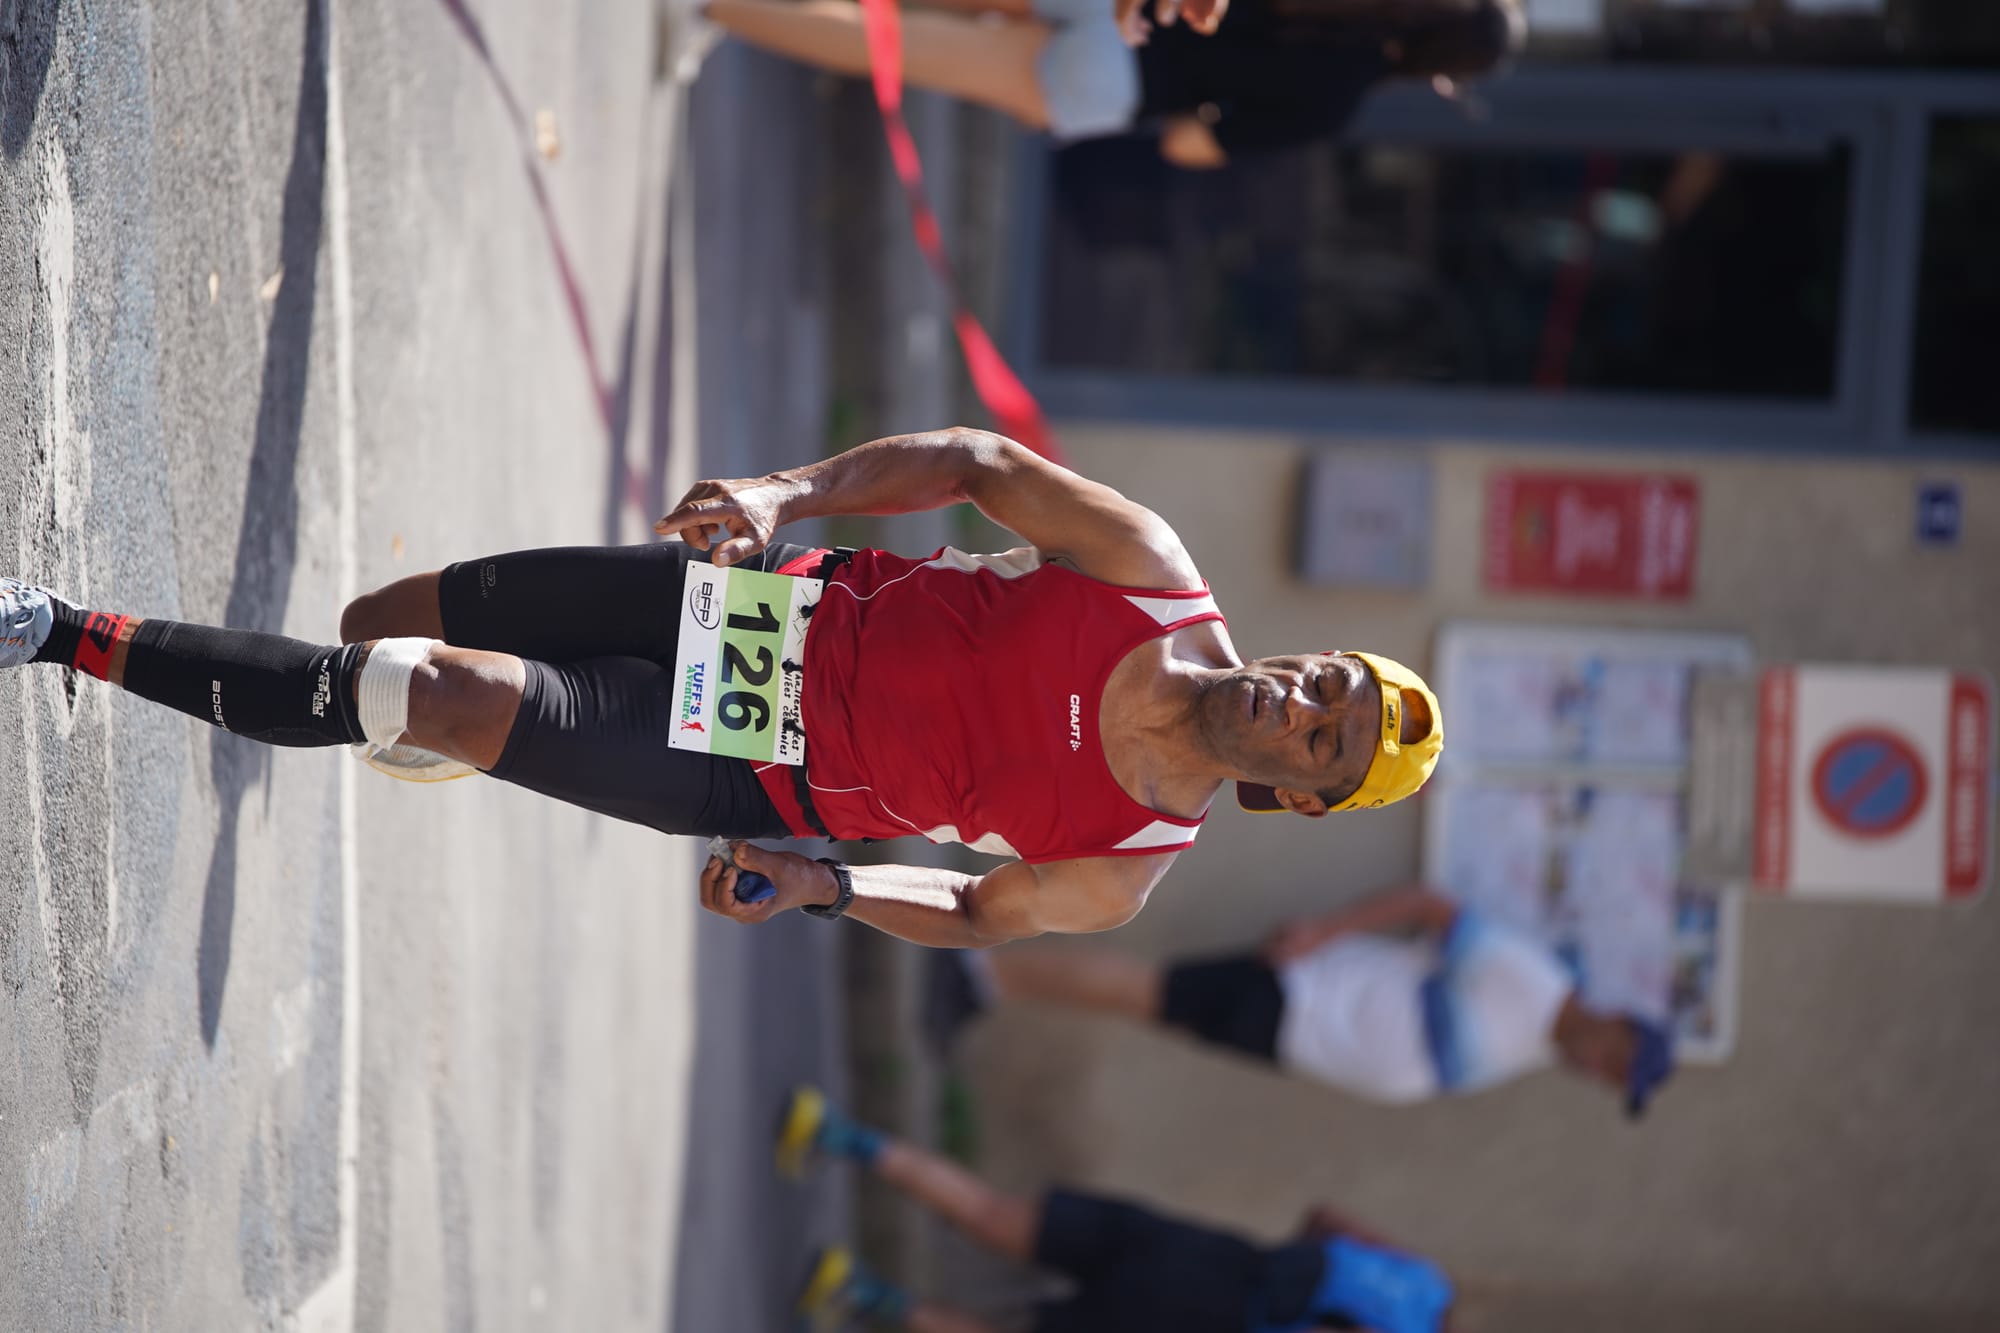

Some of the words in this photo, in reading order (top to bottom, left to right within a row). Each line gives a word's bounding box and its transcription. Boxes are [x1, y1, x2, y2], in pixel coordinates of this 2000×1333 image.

[699, 582, 714, 622] BFP
[682, 664, 697, 720] Aventure
[690, 662, 705, 716] TUFF'S
[718, 602, 780, 733] 126
[790, 672, 803, 724] hallenge
[1070, 694, 1080, 739] CRAFT
